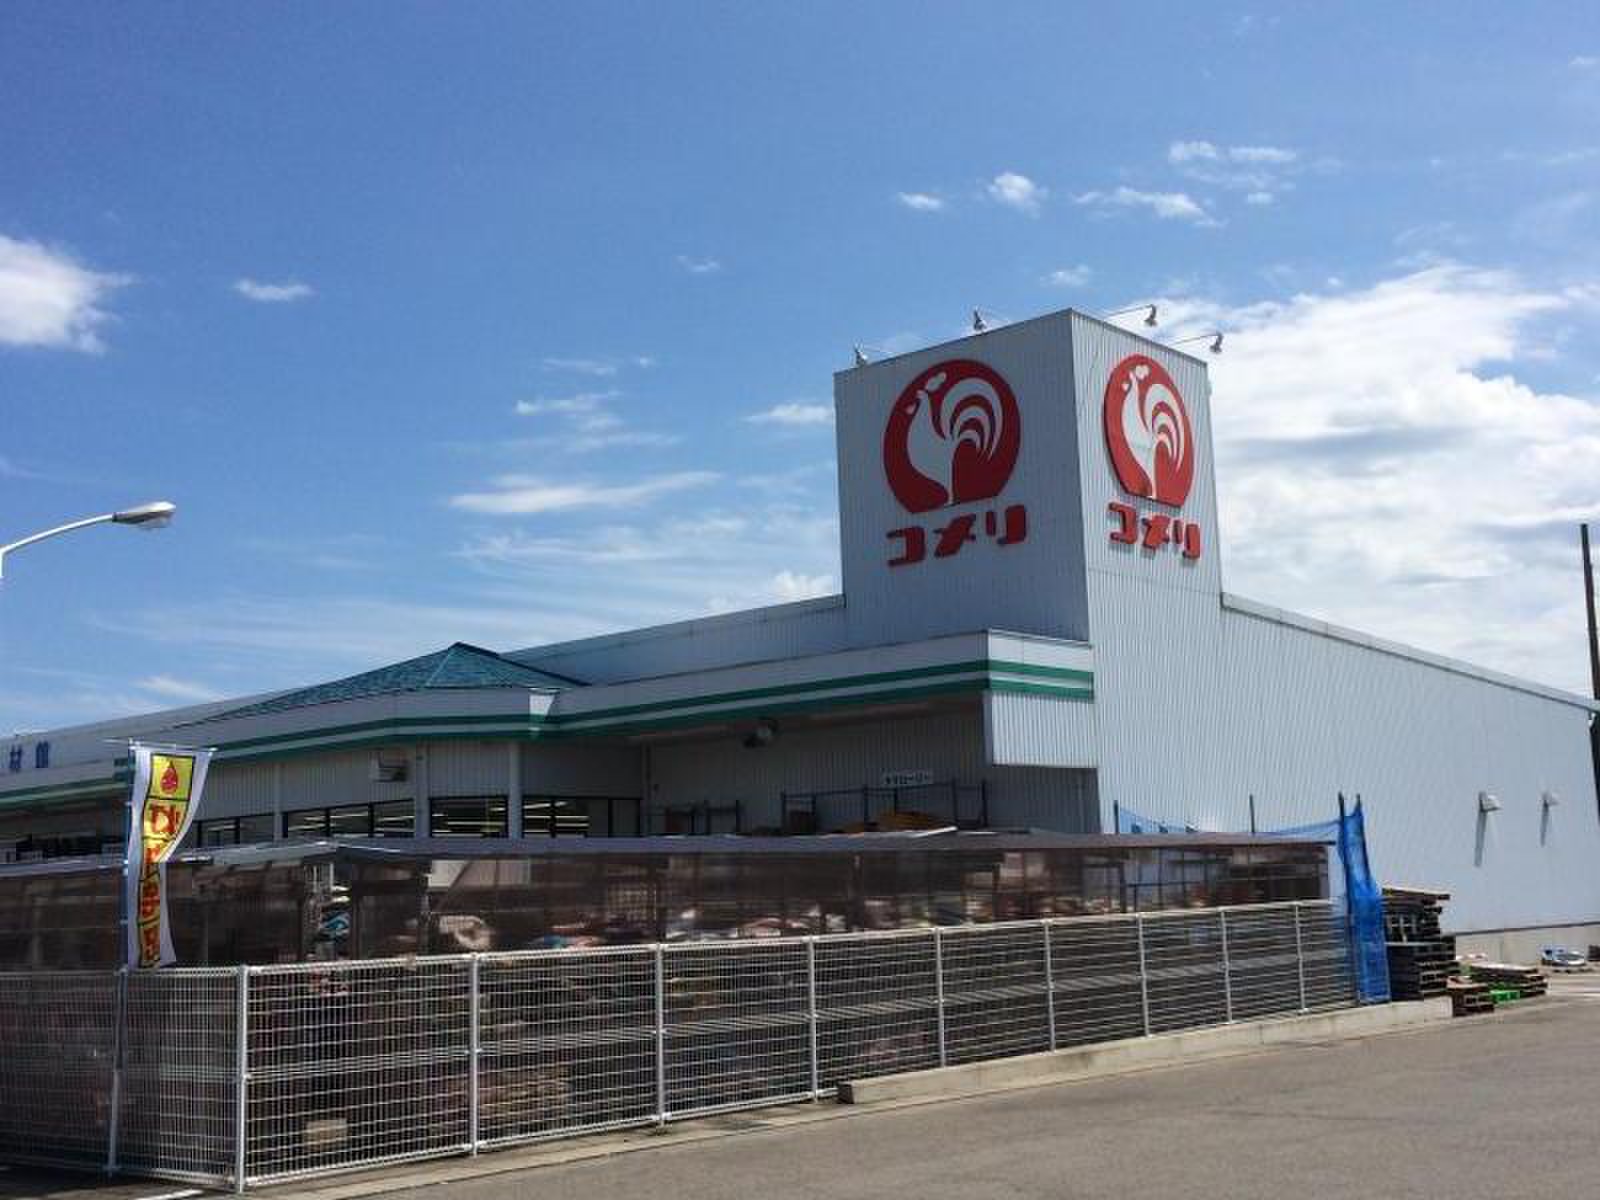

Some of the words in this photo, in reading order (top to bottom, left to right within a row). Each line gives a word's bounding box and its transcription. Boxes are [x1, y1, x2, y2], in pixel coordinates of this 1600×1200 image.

[886, 504, 1027, 567] コメリ
[1109, 502, 1201, 559] コメリ
